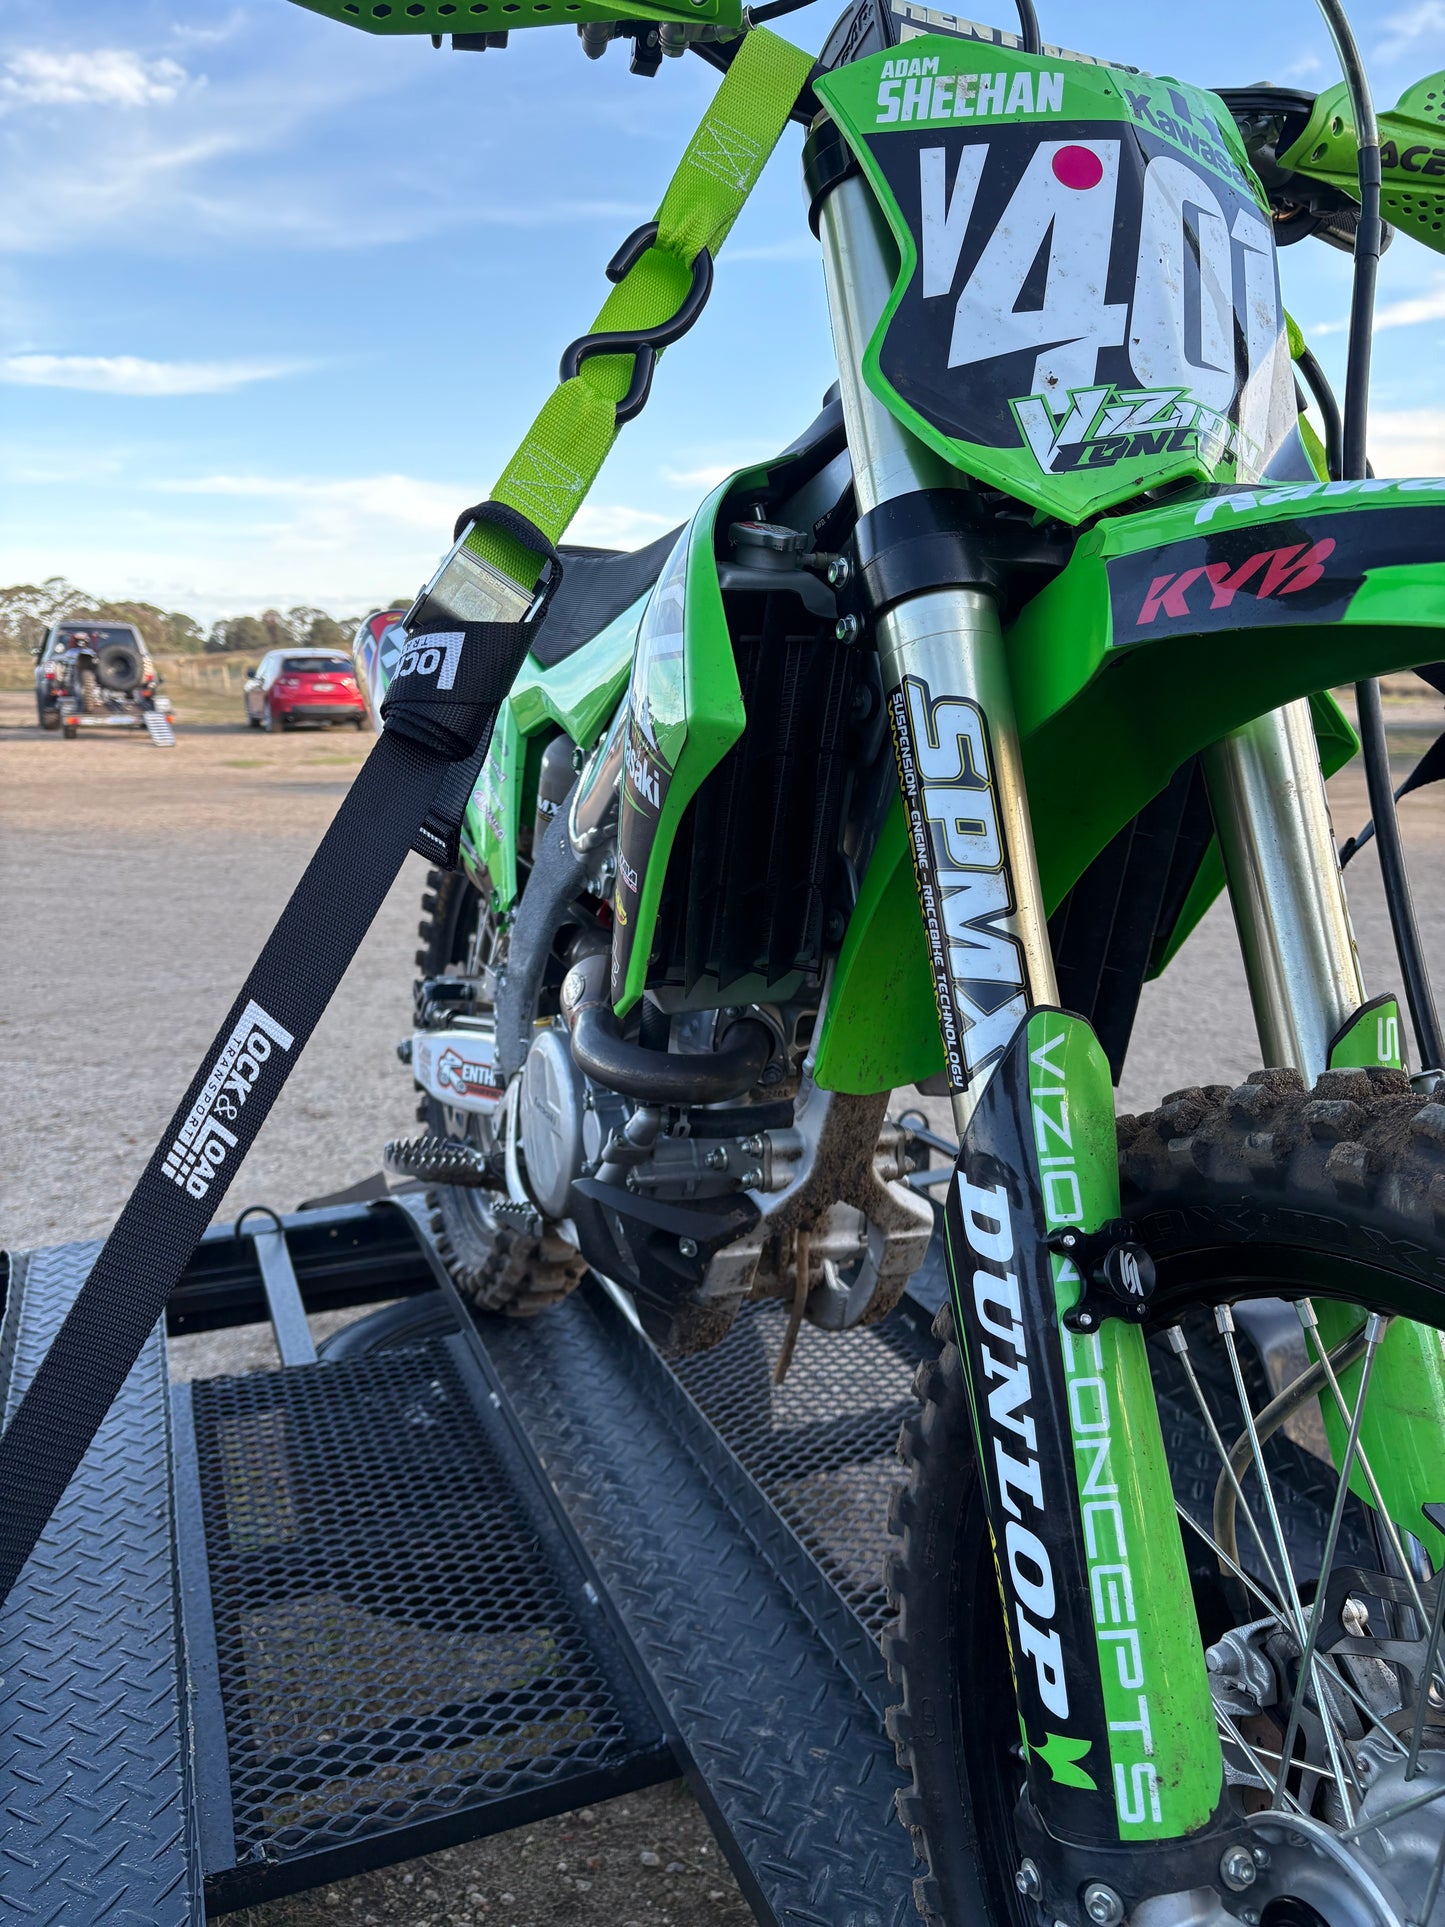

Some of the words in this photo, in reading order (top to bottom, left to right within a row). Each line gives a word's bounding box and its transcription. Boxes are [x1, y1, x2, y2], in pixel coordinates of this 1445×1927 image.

[876, 72, 1064, 123] SHEEHAN
[881, 56, 939, 79] ADAM
[1137, 538, 1336, 625] KYB
[893, 692, 918, 796] SUSPENSION
[911, 810, 929, 869] ENGINE
[922, 884, 945, 967] RACEBIKE
[936, 974, 964, 1088] TECHNOLOGY
[906, 679, 1028, 1074] SPMX
[184, 1036, 243, 1141] TRANSPORT
[223, 998, 295, 1107] LOCK
[213, 1094, 238, 1121] &
[187, 1115, 239, 1200] LOAD
[956, 1170, 1070, 1720] DUNLOP
